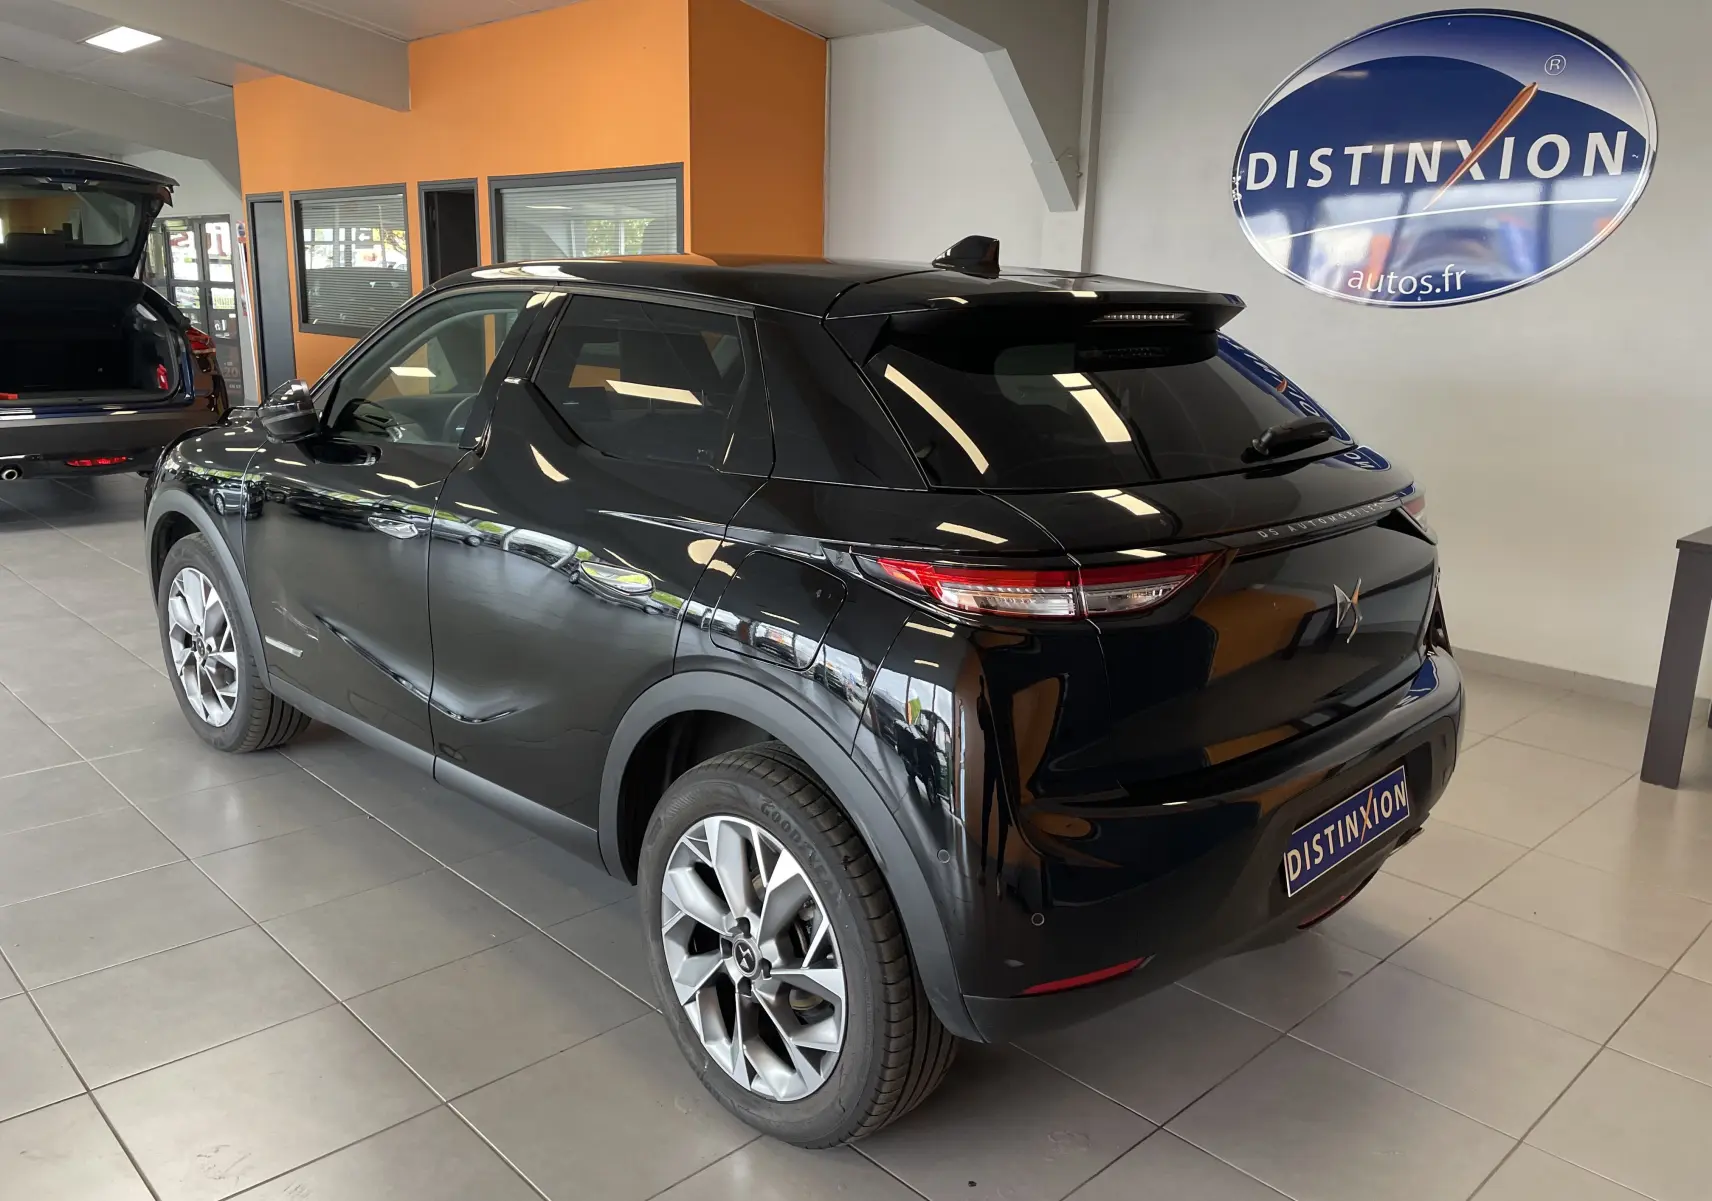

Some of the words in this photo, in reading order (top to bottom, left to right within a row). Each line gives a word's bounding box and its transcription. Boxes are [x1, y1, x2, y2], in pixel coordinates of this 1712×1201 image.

[1347, 263, 1467, 295] autos.fr
[1257, 528, 1279, 539] DS
[1288, 503, 1384, 533] AUTOMOBILES
[1287, 781, 1407, 881] DISTINXION
